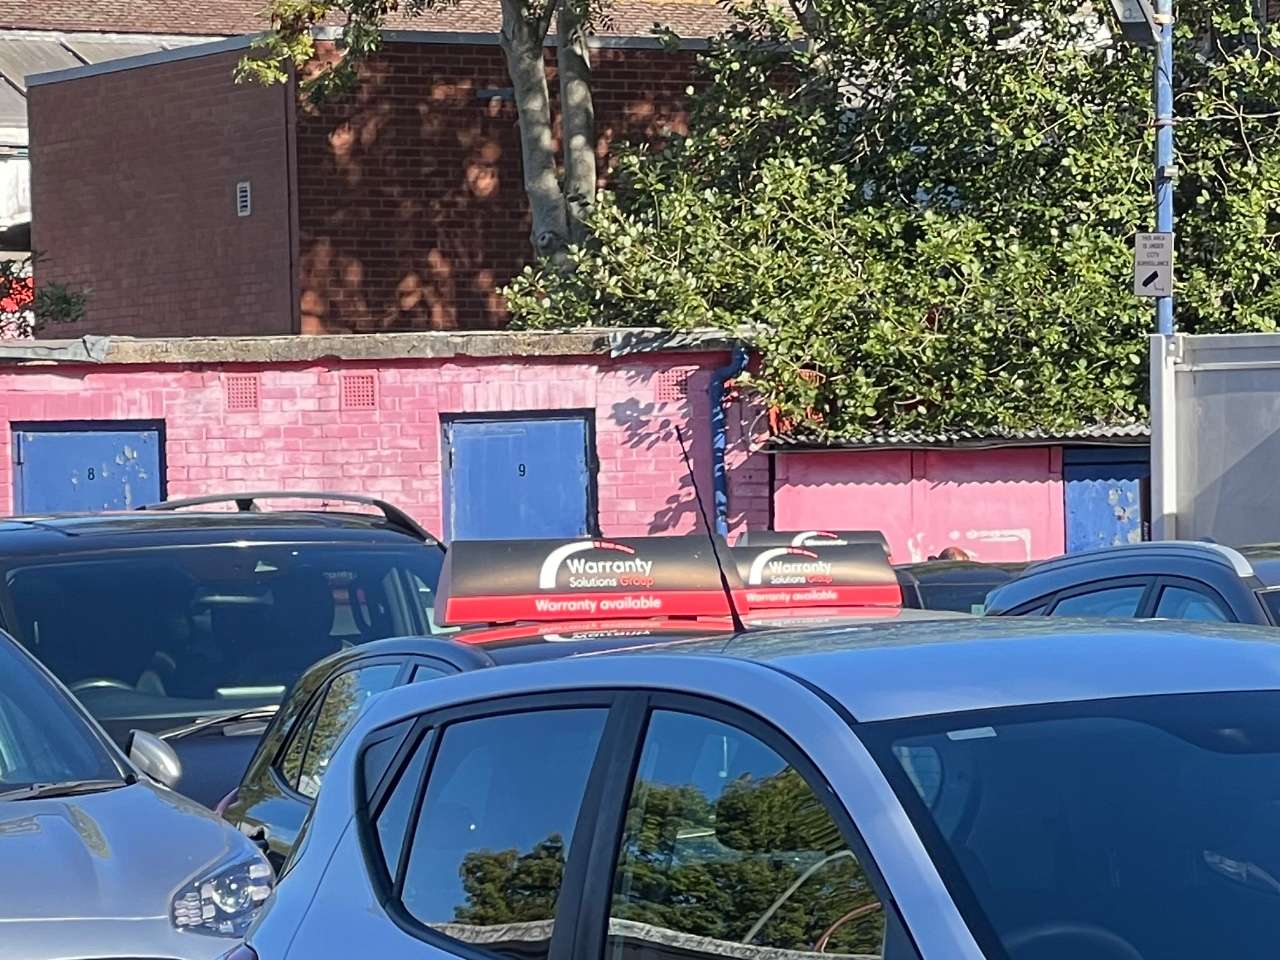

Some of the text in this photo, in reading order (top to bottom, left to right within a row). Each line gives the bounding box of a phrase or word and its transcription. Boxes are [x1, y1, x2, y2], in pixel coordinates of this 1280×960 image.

[87, 467, 95, 480] 8
[518, 463, 526, 477] 9
[566, 558, 653, 575] Warranty
[768, 561, 832, 574] Warranty
[570, 575, 656, 588] Solutions Group
[770, 575, 806, 584] Solutions
[745, 591, 838, 602] Warranty available
[535, 596, 662, 613] Warranty available
